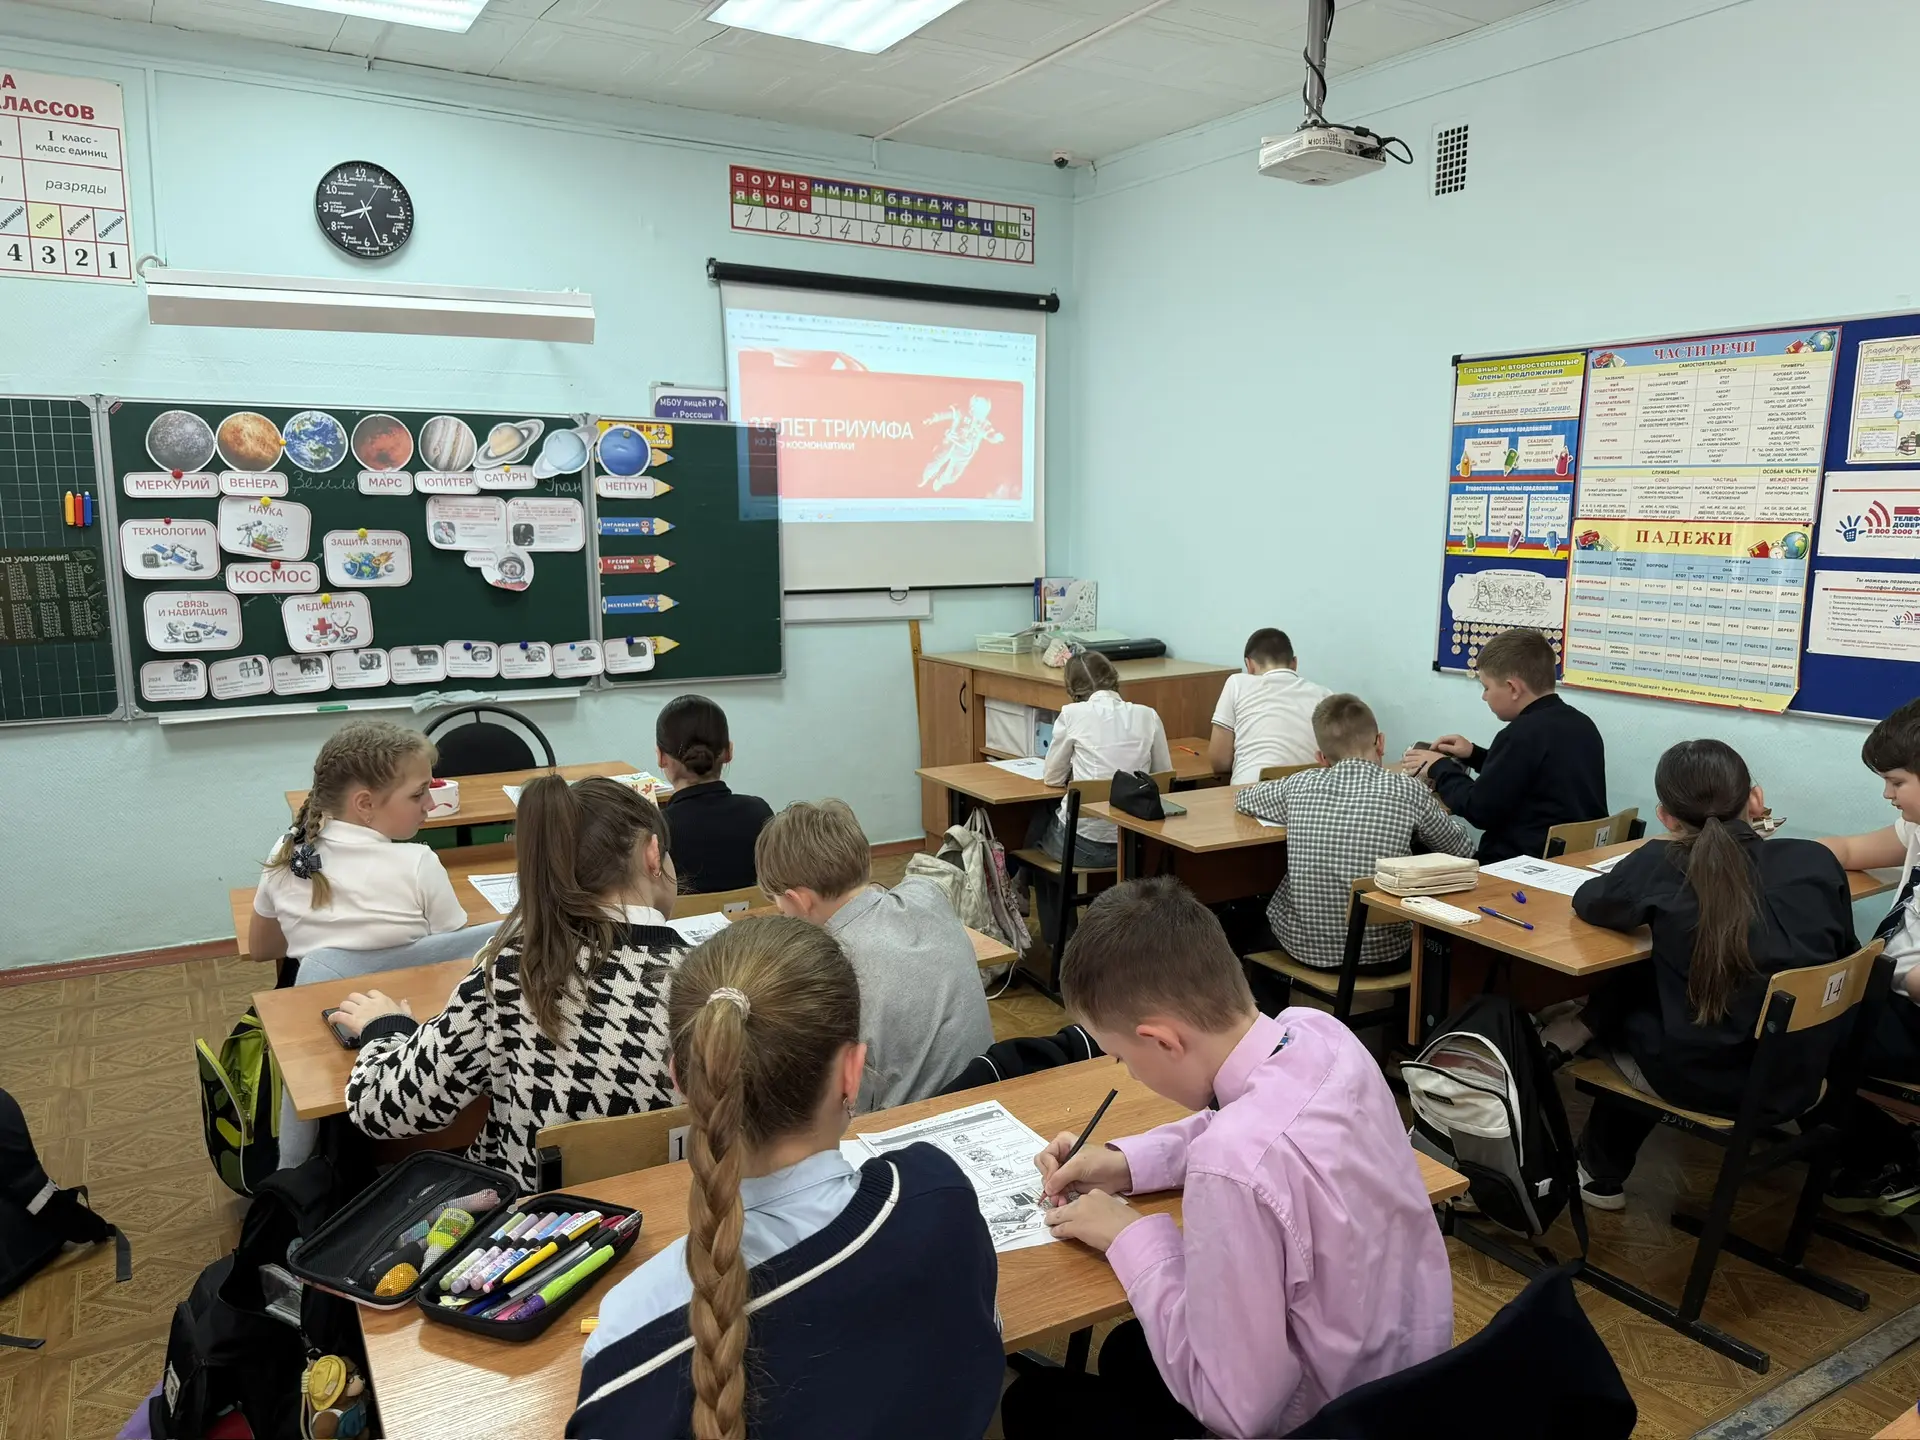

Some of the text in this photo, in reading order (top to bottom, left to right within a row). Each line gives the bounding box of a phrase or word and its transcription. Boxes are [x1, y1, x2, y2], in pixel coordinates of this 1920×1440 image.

[0, 95, 95, 120] ЛАССОВ
[62, 132, 92, 143] класс
[36, 143, 108, 159] класс единиц
[337, 173, 349, 182] 11
[355, 168, 366, 178] 12
[379, 176, 385, 186] 1
[45, 180, 107, 194] разряды
[326, 184, 337, 194] 10
[392, 189, 398, 199] 2
[323, 202, 329, 213] 9
[400, 206, 405, 217] 3
[36, 212, 55, 229] сотни
[66, 213, 92, 236] десятки
[330, 221, 337, 231] 8
[98, 215, 124, 238] единицы
[341, 232, 347, 242] 7
[382, 234, 389, 243] 5
[745, 208, 1025, 260] 1 2 3 4 5 6 7 8 9 0
[364, 237, 371, 247] 6
[7, 244, 117, 268] 4 3 2 1
[1653, 340, 1757, 361] ЧАСТИ РЕЧИ
[1463, 365, 1498, 374] Главные
[1508, 358, 1580, 371] второстепенные
[1678, 359, 1727, 368] САМОСТОЯТЕЛЬНЫЕ
[1505, 368, 1563, 380] предложения
[1468, 390, 1491, 398] Завтра
[1497, 387, 1537, 397] родителями
[660, 398, 682, 407] МБОУ
[684, 399, 707, 408] лицей
[679, 410, 713, 419] Россоши
[1470, 408, 1518, 416] замечательное
[781, 417, 818, 437] ЛЕТ
[821, 418, 914, 440] ТРИУМФА
[230, 477, 279, 489] ВЕНЕРА
[368, 477, 402, 488] МАРС
[424, 477, 473, 488] ЮПИТЕР
[484, 472, 528, 483] САТУРН
[135, 477, 210, 491] МЕРКУРИЙ
[605, 481, 648, 491] НЕПТУН
[248, 504, 283, 517] НАУКА
[132, 527, 207, 536] ТЕХНОЛОГИИ
[331, 538, 402, 547] ЗАЩИТА ЗЕМЛИ
[1636, 530, 1734, 547] ПАДЕЖИ
[13, 553, 70, 564] умножения
[235, 569, 311, 584] КОСМОС
[176, 600, 209, 609] СВЯЗЬ
[297, 600, 355, 612] МЕДИЦИНА
[158, 607, 228, 617] И НАВИГАЦИЯ
[1597, 831, 1608, 847] 14
[1827, 977, 1843, 1001] 14
